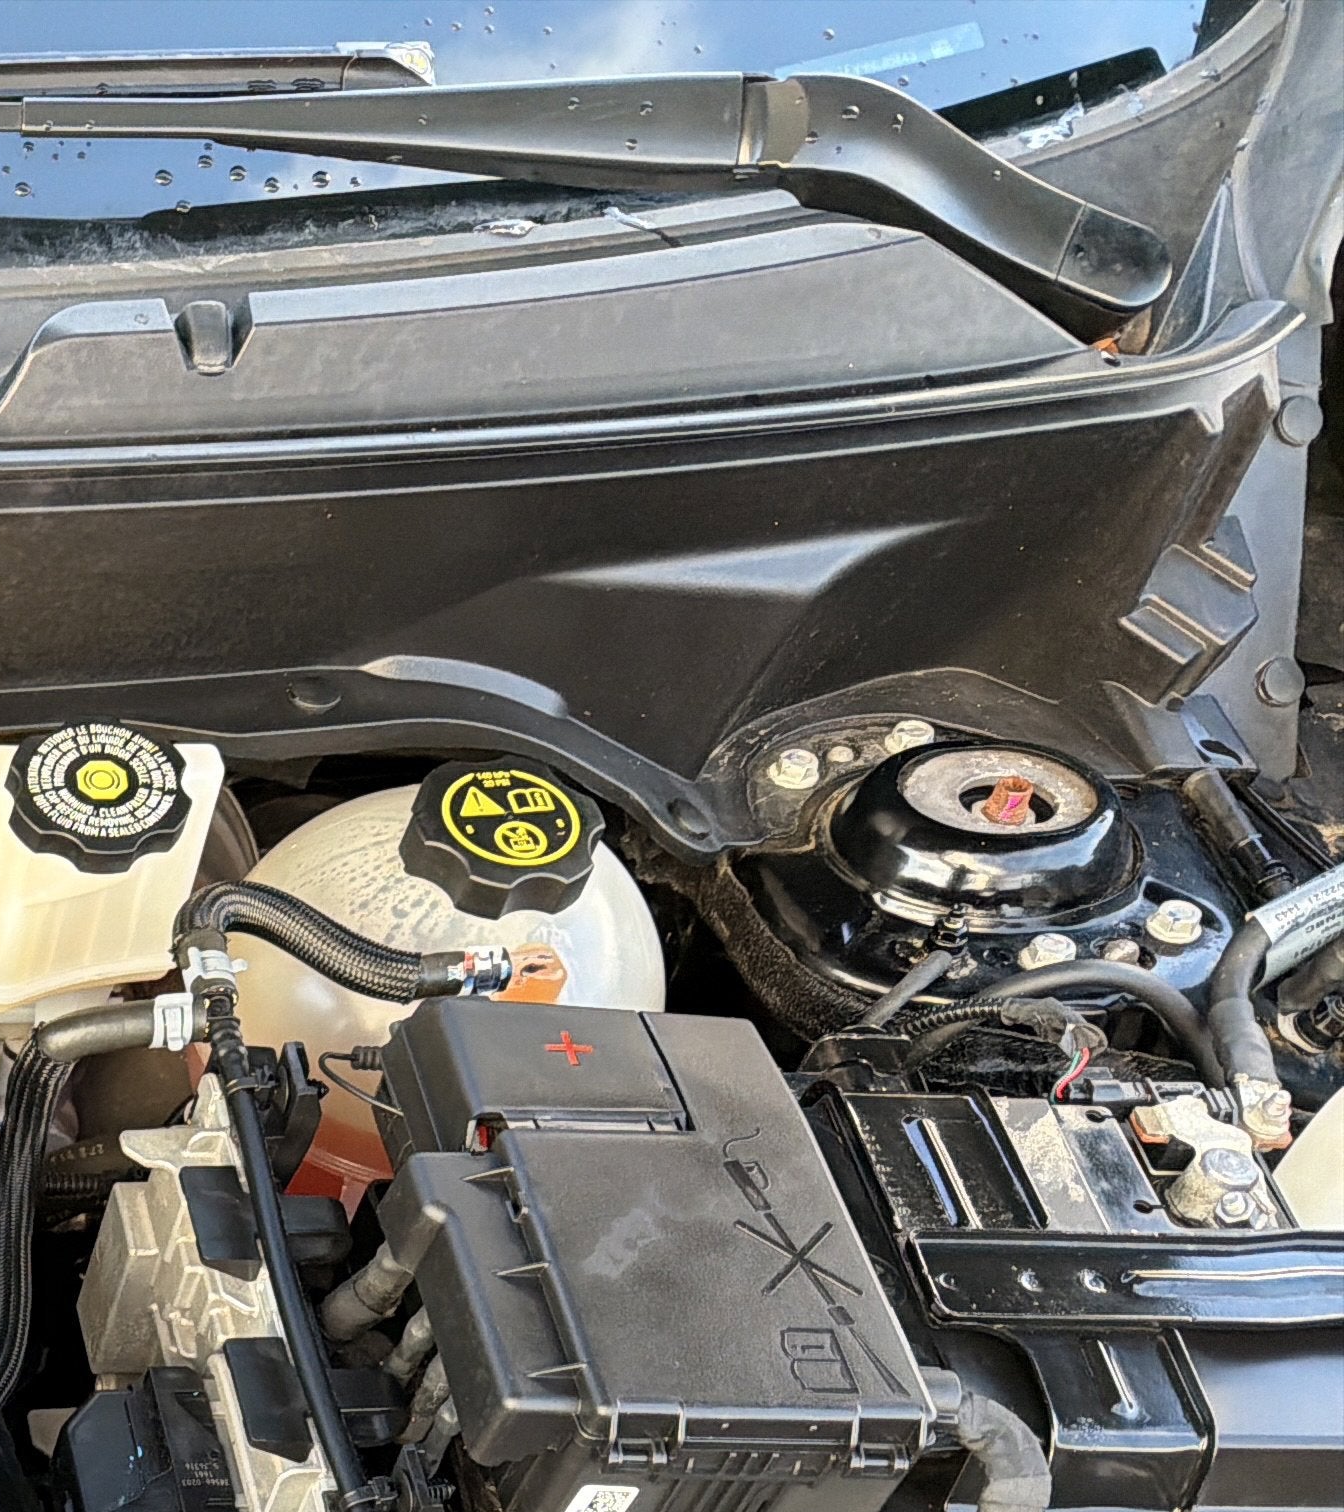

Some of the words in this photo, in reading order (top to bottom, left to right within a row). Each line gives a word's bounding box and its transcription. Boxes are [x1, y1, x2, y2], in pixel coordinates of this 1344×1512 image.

[76, 735, 89, 745] DU
[92, 734, 126, 747] LIQUIDE
[76, 725, 87, 735] LE
[89, 723, 133, 739] BOUCHON
[131, 734, 160, 753] AVANT
[154, 751, 167, 763] LA
[45, 790, 61, 805] CAP
[56, 803, 88, 824] BEFORE
[99, 804, 131, 818] CLEAN
[48, 810, 73, 828] FLUID
[72, 824, 99, 837] FROM
[99, 828, 107, 837] A
[108, 824, 141, 838] SEALED
